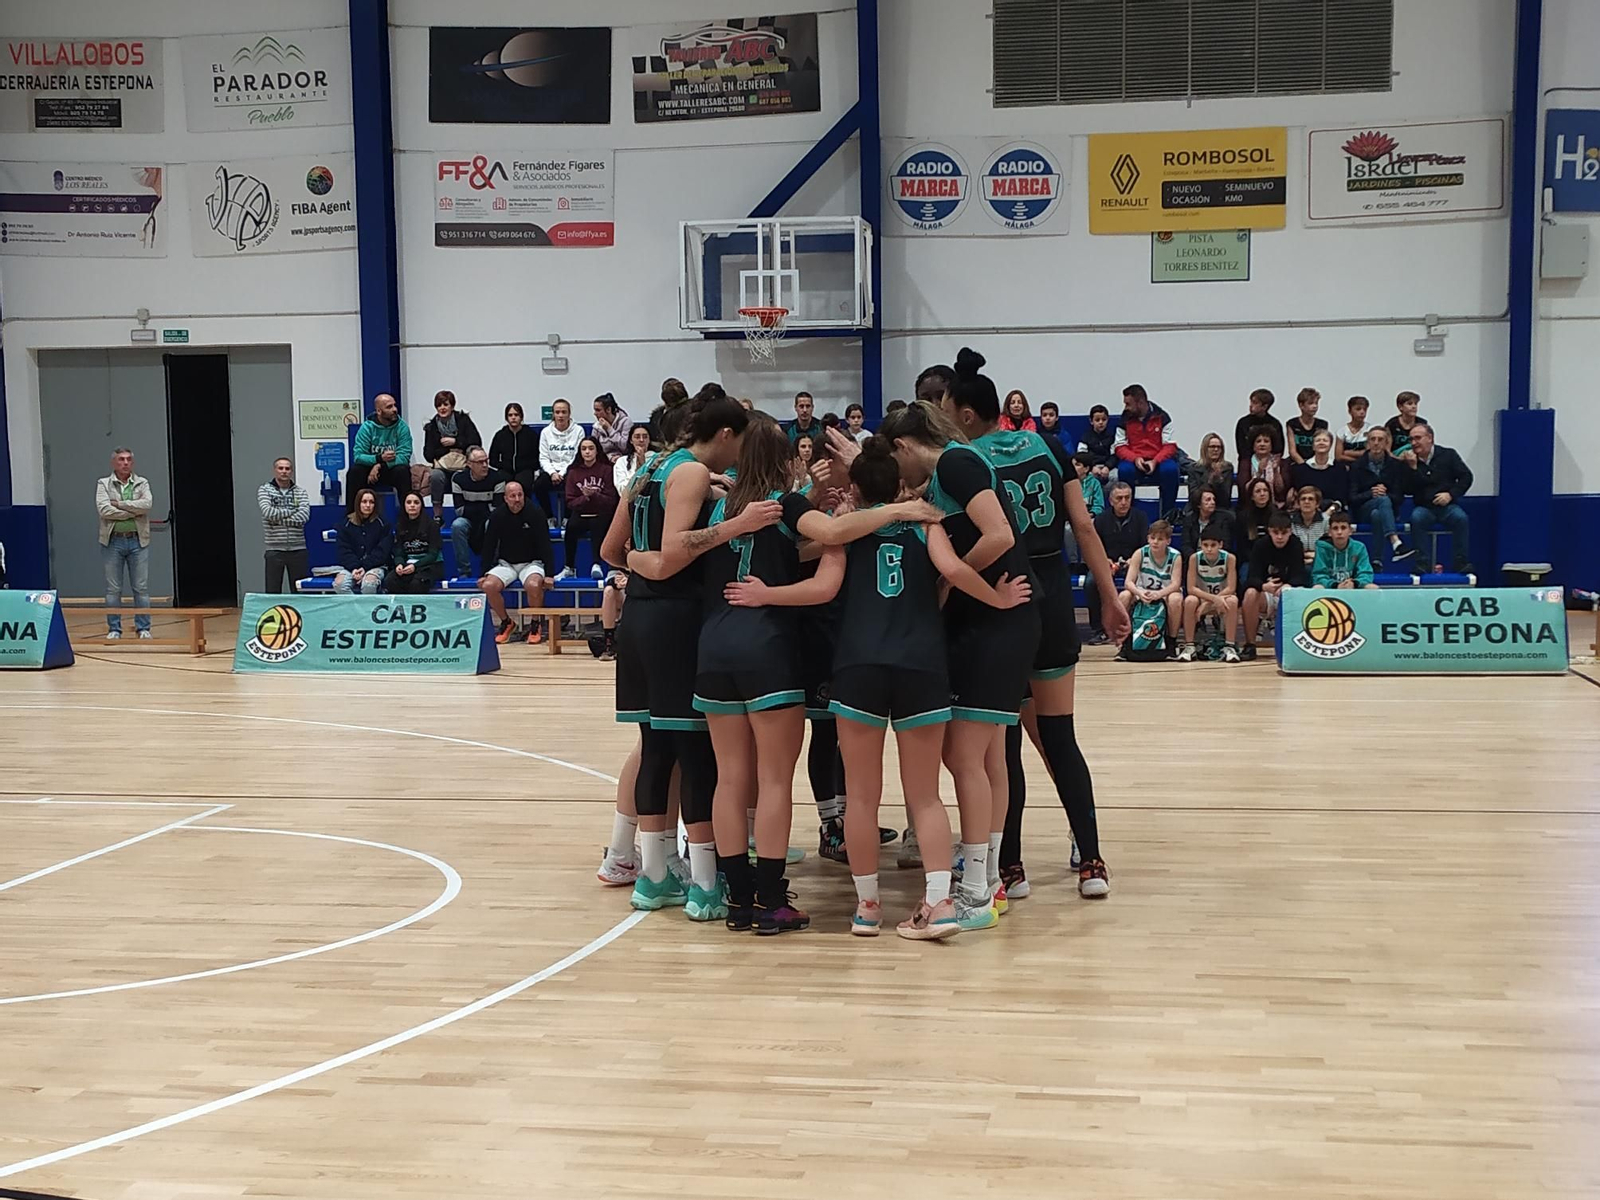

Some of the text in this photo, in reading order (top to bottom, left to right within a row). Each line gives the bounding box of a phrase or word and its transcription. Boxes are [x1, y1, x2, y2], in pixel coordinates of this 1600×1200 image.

[9, 43, 144, 66] VILLALOBOS
[724, 38, 776, 64] ABC
[212, 64, 225, 73] EL
[0, 75, 154, 90] CERRAJERIA ESTEPONA
[213, 70, 328, 93] PARADOR
[674, 78, 776, 95] MECANICA EN GENERAL
[214, 90, 327, 102] RESTAURANTE
[658, 96, 745, 109] WWW.TALLERESABC.COM
[247, 105, 295, 124] Pueblo
[701, 106, 727, 114] ESTEPONA
[1163, 148, 1275, 167] ROMBOSOL
[513, 160, 605, 172] Fernández Figares
[906, 162, 953, 174] RADIO
[998, 161, 1044, 174] RADIO
[513, 171, 571, 181] & Asociados
[1348, 175, 1463, 189] JARDINES PISCINAS
[900, 179, 959, 197] MARCA
[992, 178, 1051, 196] MARCA
[1172, 182, 1274, 193] NUEVO SEMINUEVO
[291, 200, 351, 216] FIBA Agent
[1101, 198, 1149, 208] RENAULT
[1428, 199, 1449, 207] 777
[255, 202, 281, 246] SPORTS AGENCY
[291, 224, 356, 236] www.jpsportsagency.com
[913, 221, 943, 230] MÁLAGA
[1004, 220, 1034, 229] MÁLAGA
[114, 231, 136, 239] Vicente
[567, 231, 607, 239] info@ffya.es
[1188, 234, 1214, 243] PISTA
[1176, 247, 1227, 257] LEONARDO
[1164, 262, 1199, 271] TORRES
[729, 535, 754, 582] 7
[876, 543, 904, 598] 6
[1146, 577, 1163, 590] 23
[1207, 585, 1221, 595] 16
[1434, 596, 1500, 617] CAB
[371, 604, 427, 625] CAB
[0, 621, 38, 641] NA
[1380, 623, 1558, 644] ESTEPONA
[320, 629, 472, 649] ESTEPONA
[248, 640, 305, 662] ESTEPONA
[1296, 636, 1363, 658] ESTEPONA
[329, 655, 460, 665] www.baloncestoestepona.com
[1394, 651, 1548, 660] www.baloncestoestepona.com
